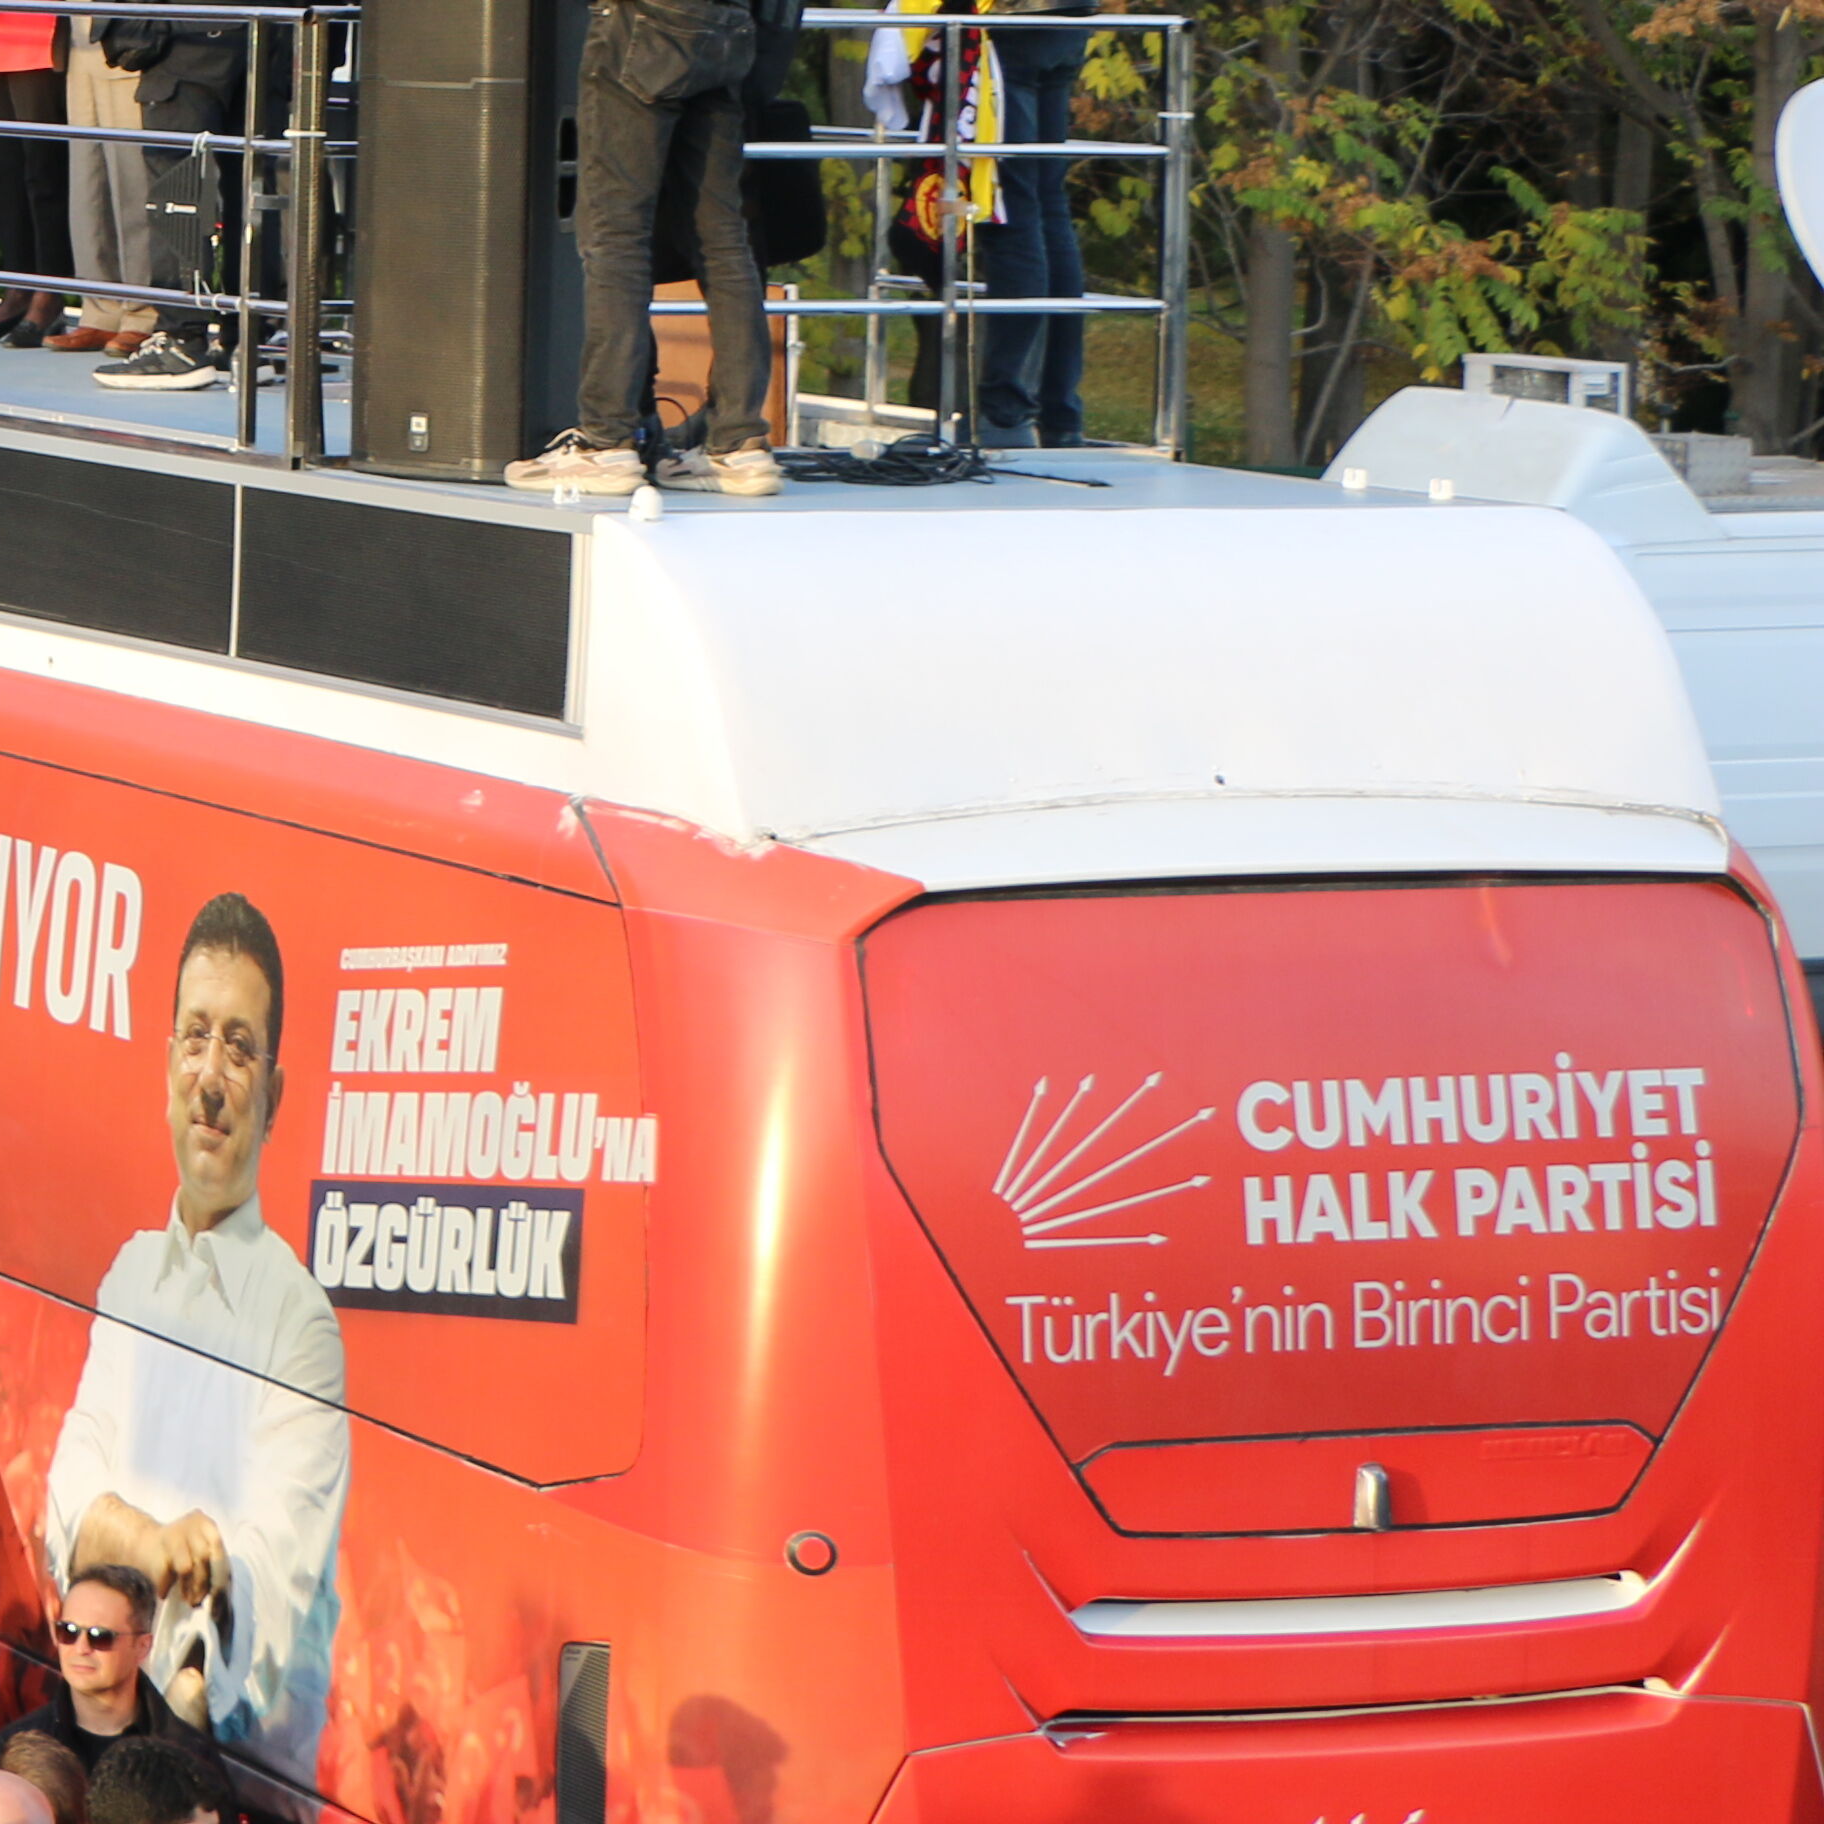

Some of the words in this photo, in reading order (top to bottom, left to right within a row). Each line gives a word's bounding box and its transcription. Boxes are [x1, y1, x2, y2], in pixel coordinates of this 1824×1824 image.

[330, 986, 504, 1073] EKREM
[320, 1080, 658, 1184] İMAMOĞLU'NA
[1236, 1051, 1705, 1152] CUMHURİYET
[313, 1189, 572, 1300] ÖZGÜRLÜK
[1243, 1169, 1438, 1246] HALK
[1455, 1139, 1719, 1237] PARTİSİ
[1004, 1285, 1334, 1377] Türkiye'nin
[1352, 1275, 1529, 1350] Birinci
[1549, 1266, 1721, 1339] Partisi
